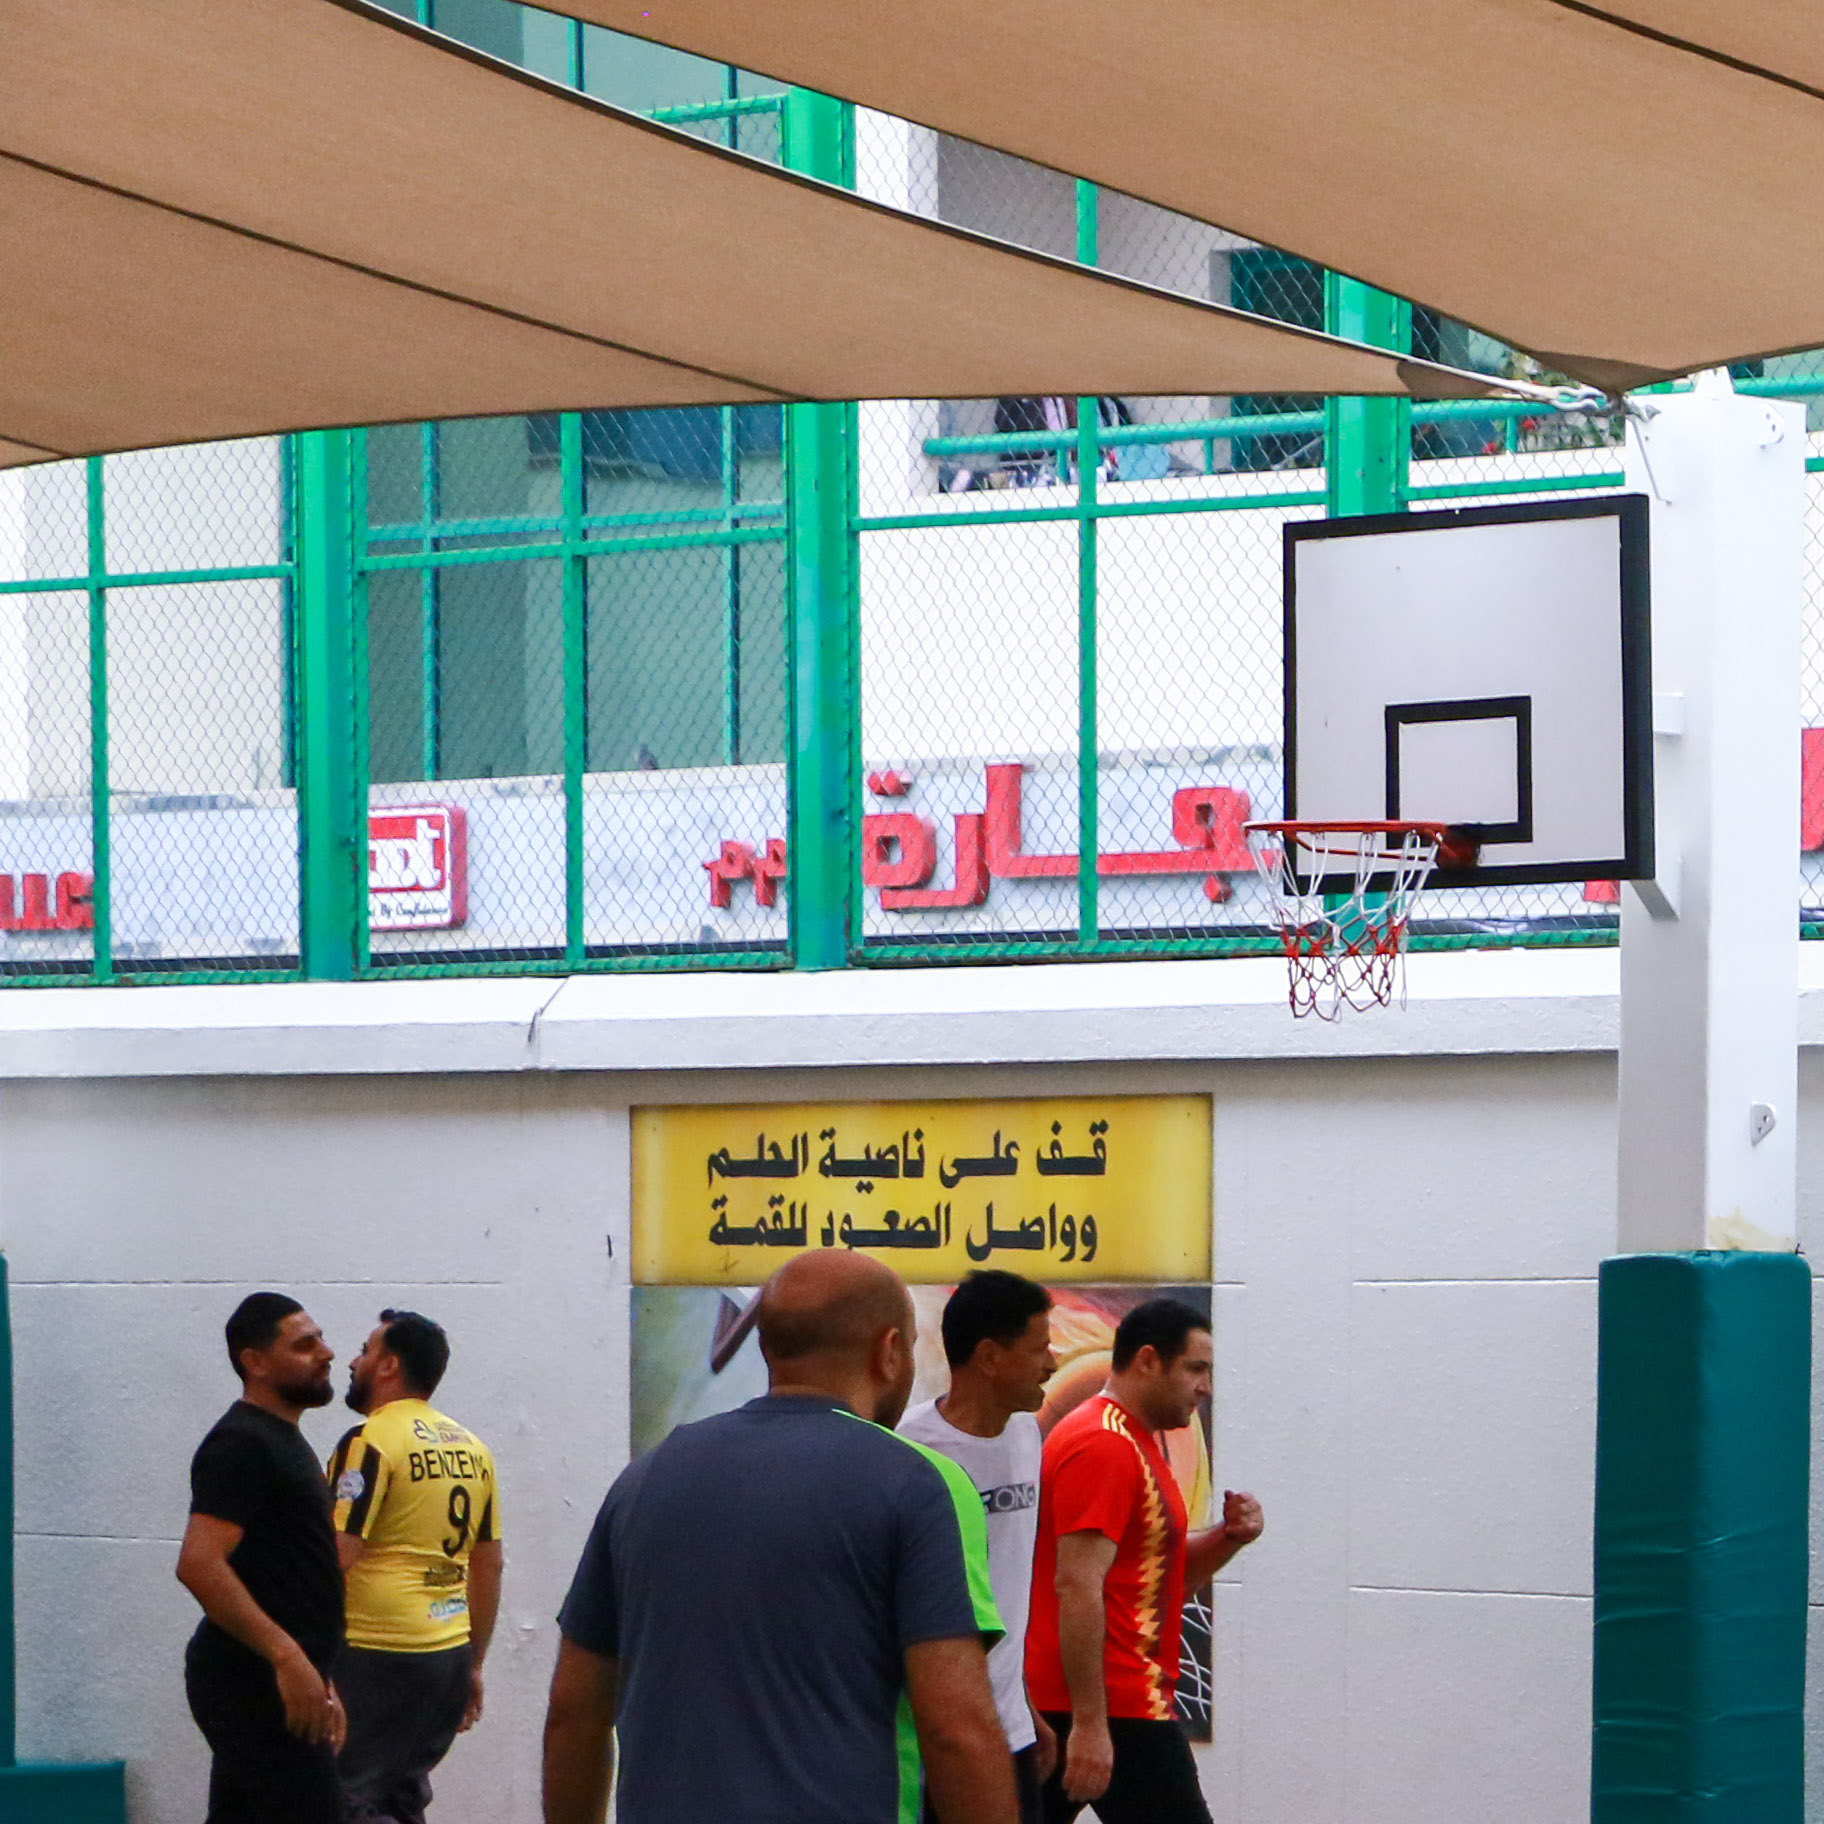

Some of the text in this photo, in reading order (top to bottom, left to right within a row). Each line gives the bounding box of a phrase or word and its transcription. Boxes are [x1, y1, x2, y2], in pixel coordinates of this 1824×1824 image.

[706, 1119, 1109, 1195] قف على ناصية الحلم
[708, 1194, 1098, 1263] وواصل الصعود للقمة
[442, 1484, 472, 1558] 9
